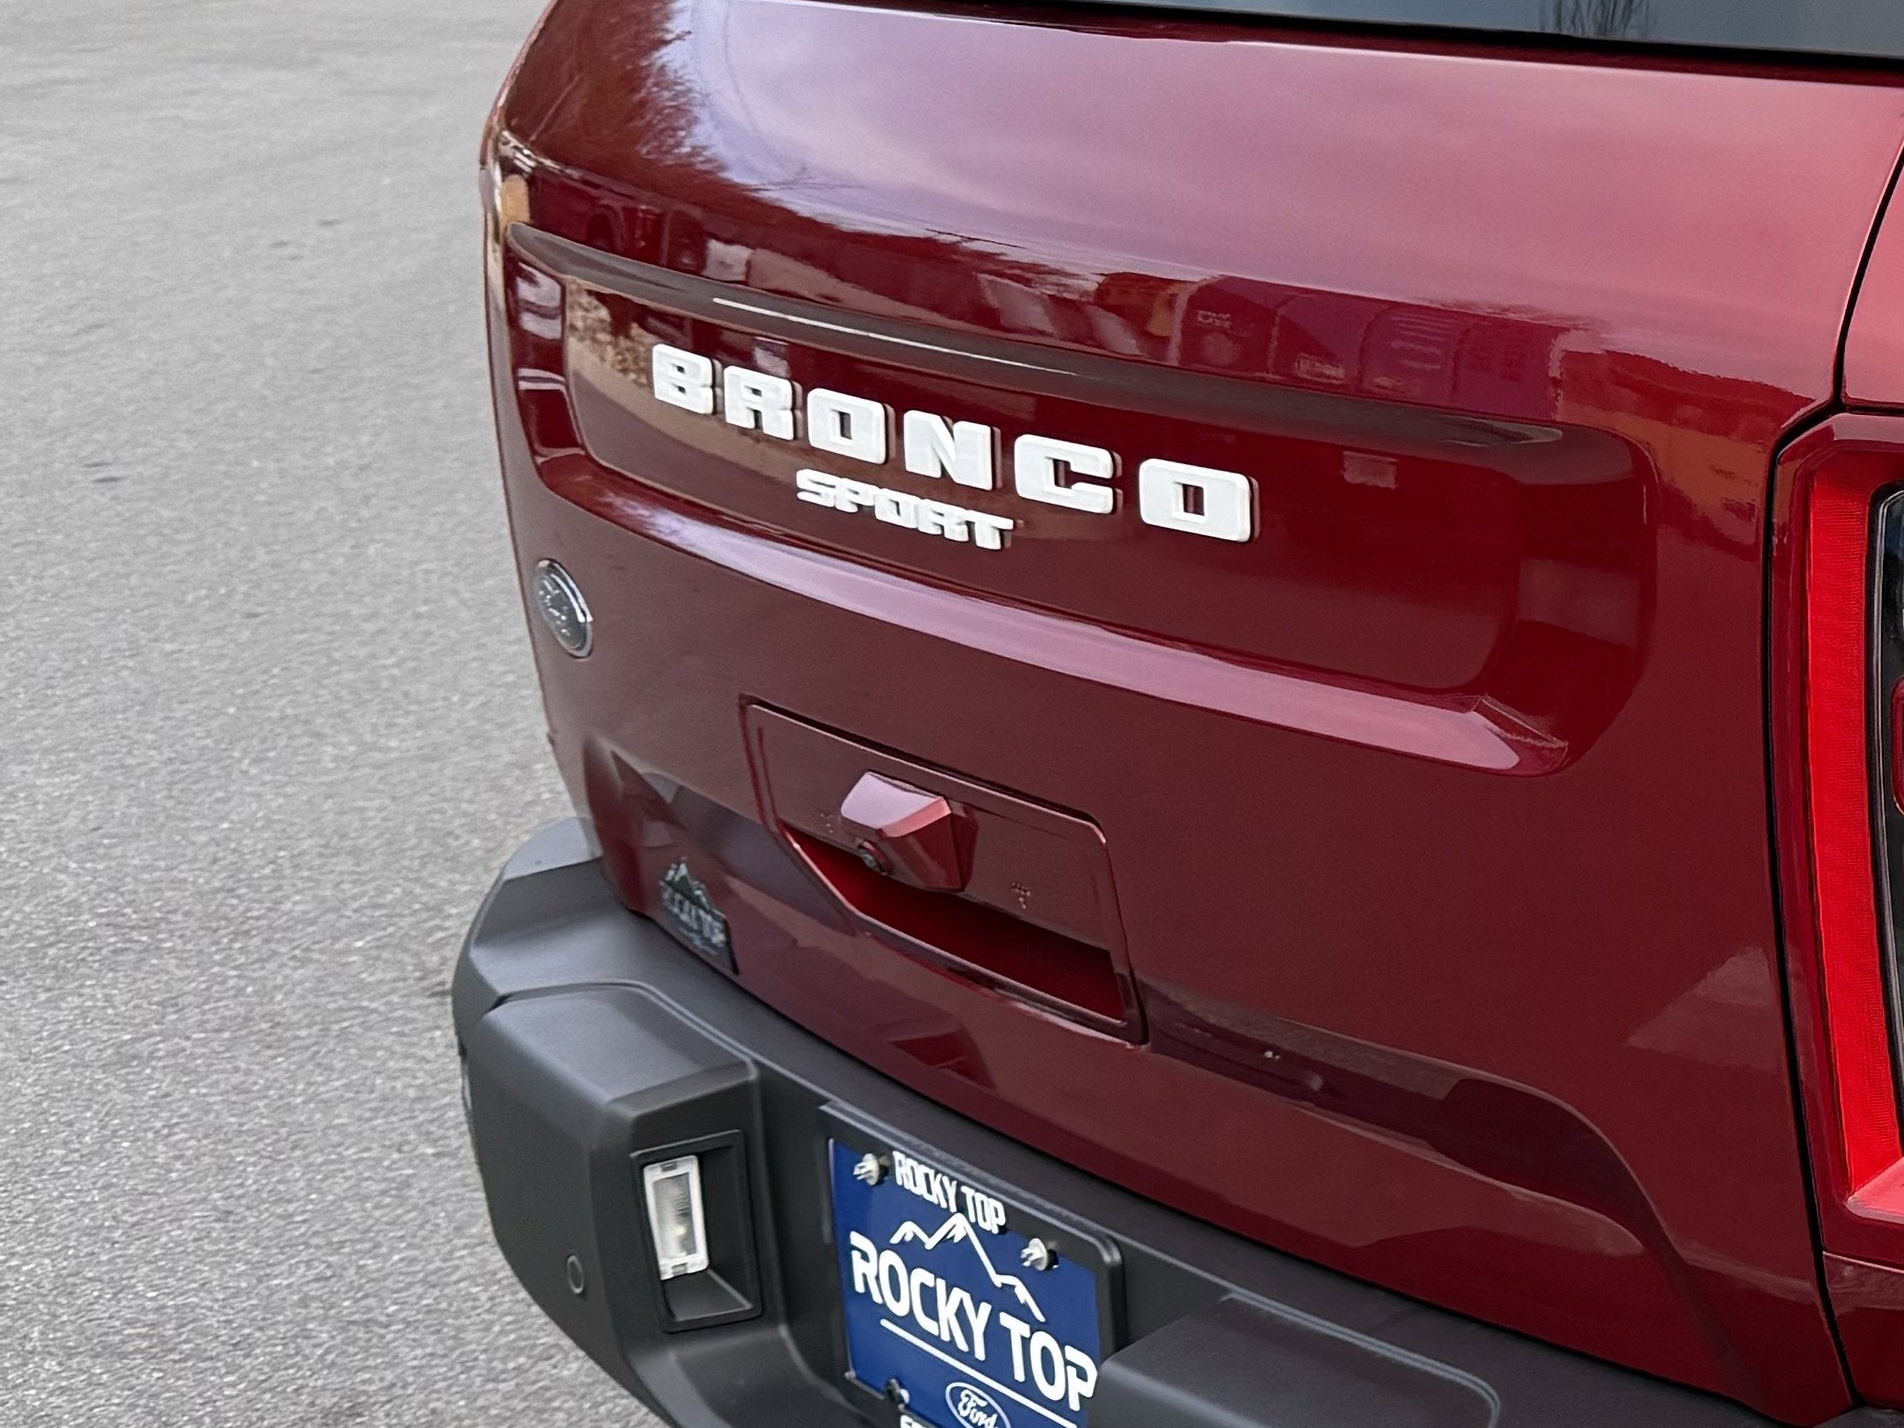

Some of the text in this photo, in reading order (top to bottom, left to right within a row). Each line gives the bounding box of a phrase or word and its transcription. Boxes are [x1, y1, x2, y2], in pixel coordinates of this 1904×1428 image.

[652, 343, 1256, 544] BRONCO
[796, 468, 1016, 551] SPORT
[893, 1151, 1006, 1234] ROCKY TOP
[849, 1231, 1098, 1413] ROCKY TOP
